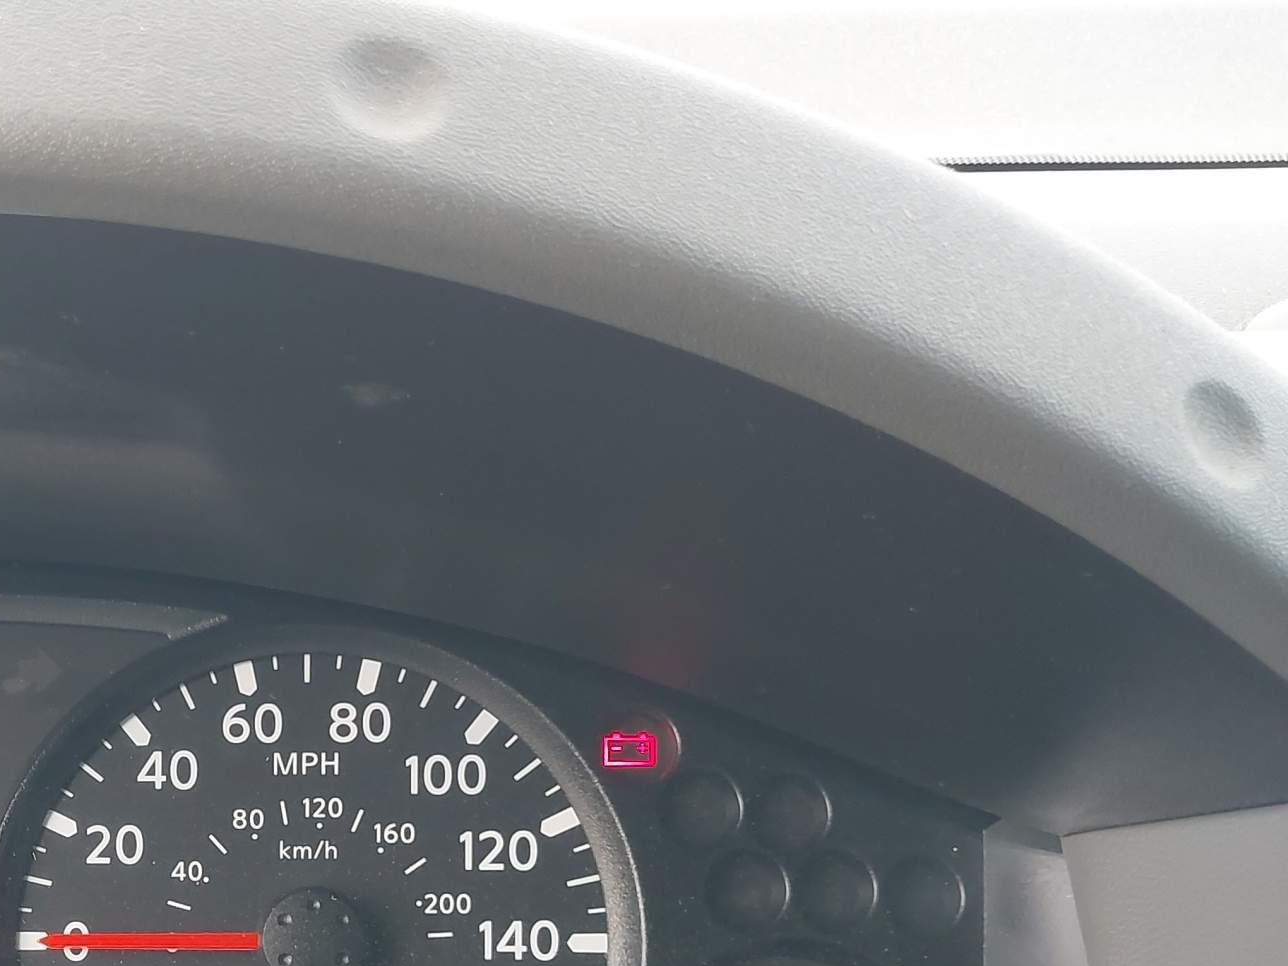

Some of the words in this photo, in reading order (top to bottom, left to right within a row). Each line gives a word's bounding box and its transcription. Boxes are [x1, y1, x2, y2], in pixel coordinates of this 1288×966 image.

[223, 704, 282, 743] 60
[330, 703, 390, 743] 80
[137, 750, 197, 790] 40
[274, 752, 339, 775] MPH
[406, 755, 486, 795] 100
[233, 809, 264, 829] 80
[303, 798, 342, 818] 120
[86, 825, 143, 864] 20
[280, 840, 337, 860] km/h
[374, 823, 415, 843] 160
[460, 830, 537, 871] 120
[171, 863, 201, 881] 40
[425, 894, 471, 914] 200
[63, 922, 89, 961] 0
[479, 925, 559, 961] 140
